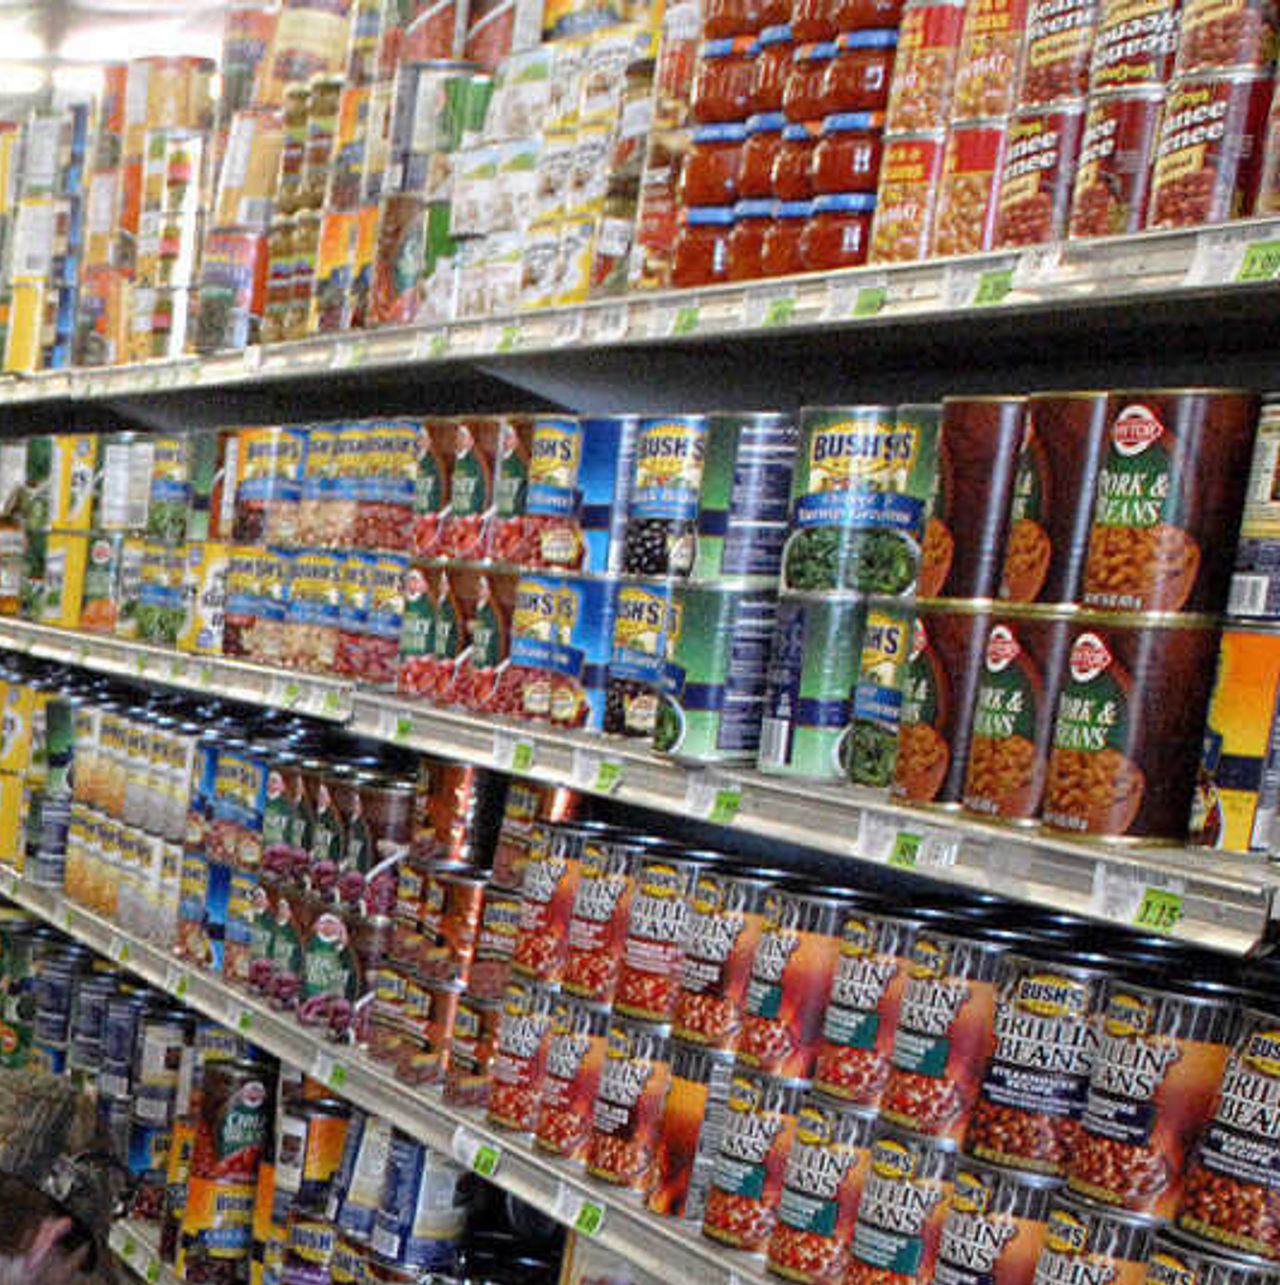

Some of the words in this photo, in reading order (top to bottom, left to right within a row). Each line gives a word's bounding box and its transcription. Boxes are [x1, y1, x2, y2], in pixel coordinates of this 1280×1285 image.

[532, 436, 572, 461] SH'S
[1150, 471, 1170, 498] &
[619, 600, 660, 625] SH'S
[1097, 701, 1117, 725] &
[1020, 980, 1086, 1008] BUSH'S
[1104, 1065, 1154, 1099] ANS
[1220, 1096, 1280, 1137] BEA
